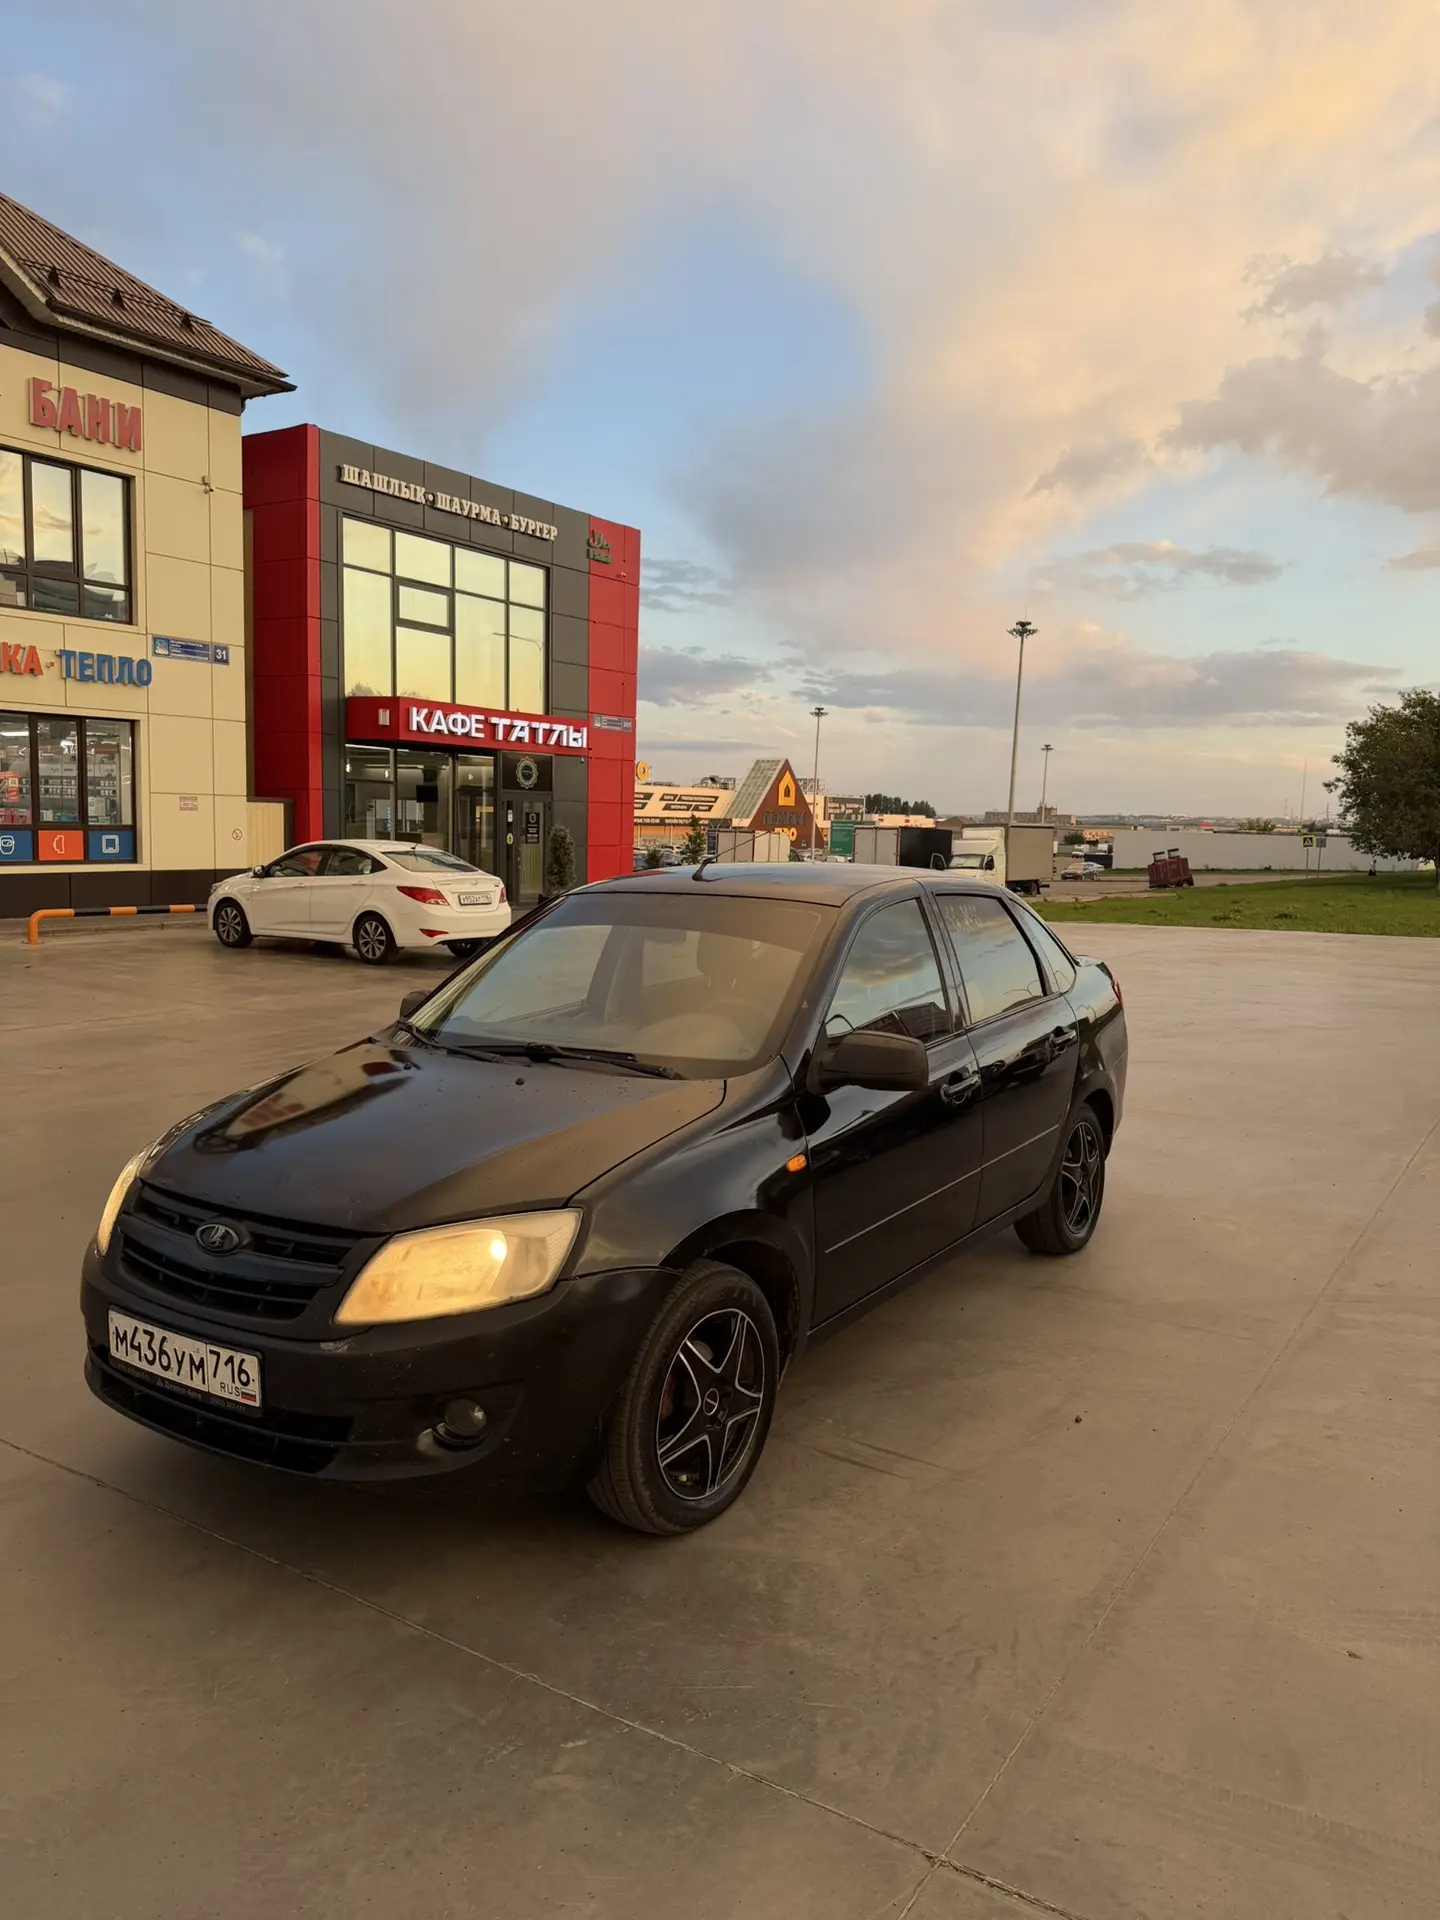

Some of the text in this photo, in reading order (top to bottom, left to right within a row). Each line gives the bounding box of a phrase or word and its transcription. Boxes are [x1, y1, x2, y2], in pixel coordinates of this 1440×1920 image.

[29, 377, 141, 452] БАНИ
[340, 463, 557, 541] ШАШЛЫК ШАУРМА БУРГЕР
[56, 649, 152, 686] ТЕПЛО
[215, 649, 227, 660] 31
[408, 706, 588, 749] КАФЕ ТАТЛЫ
[220, 1381, 240, 1396] RUS
